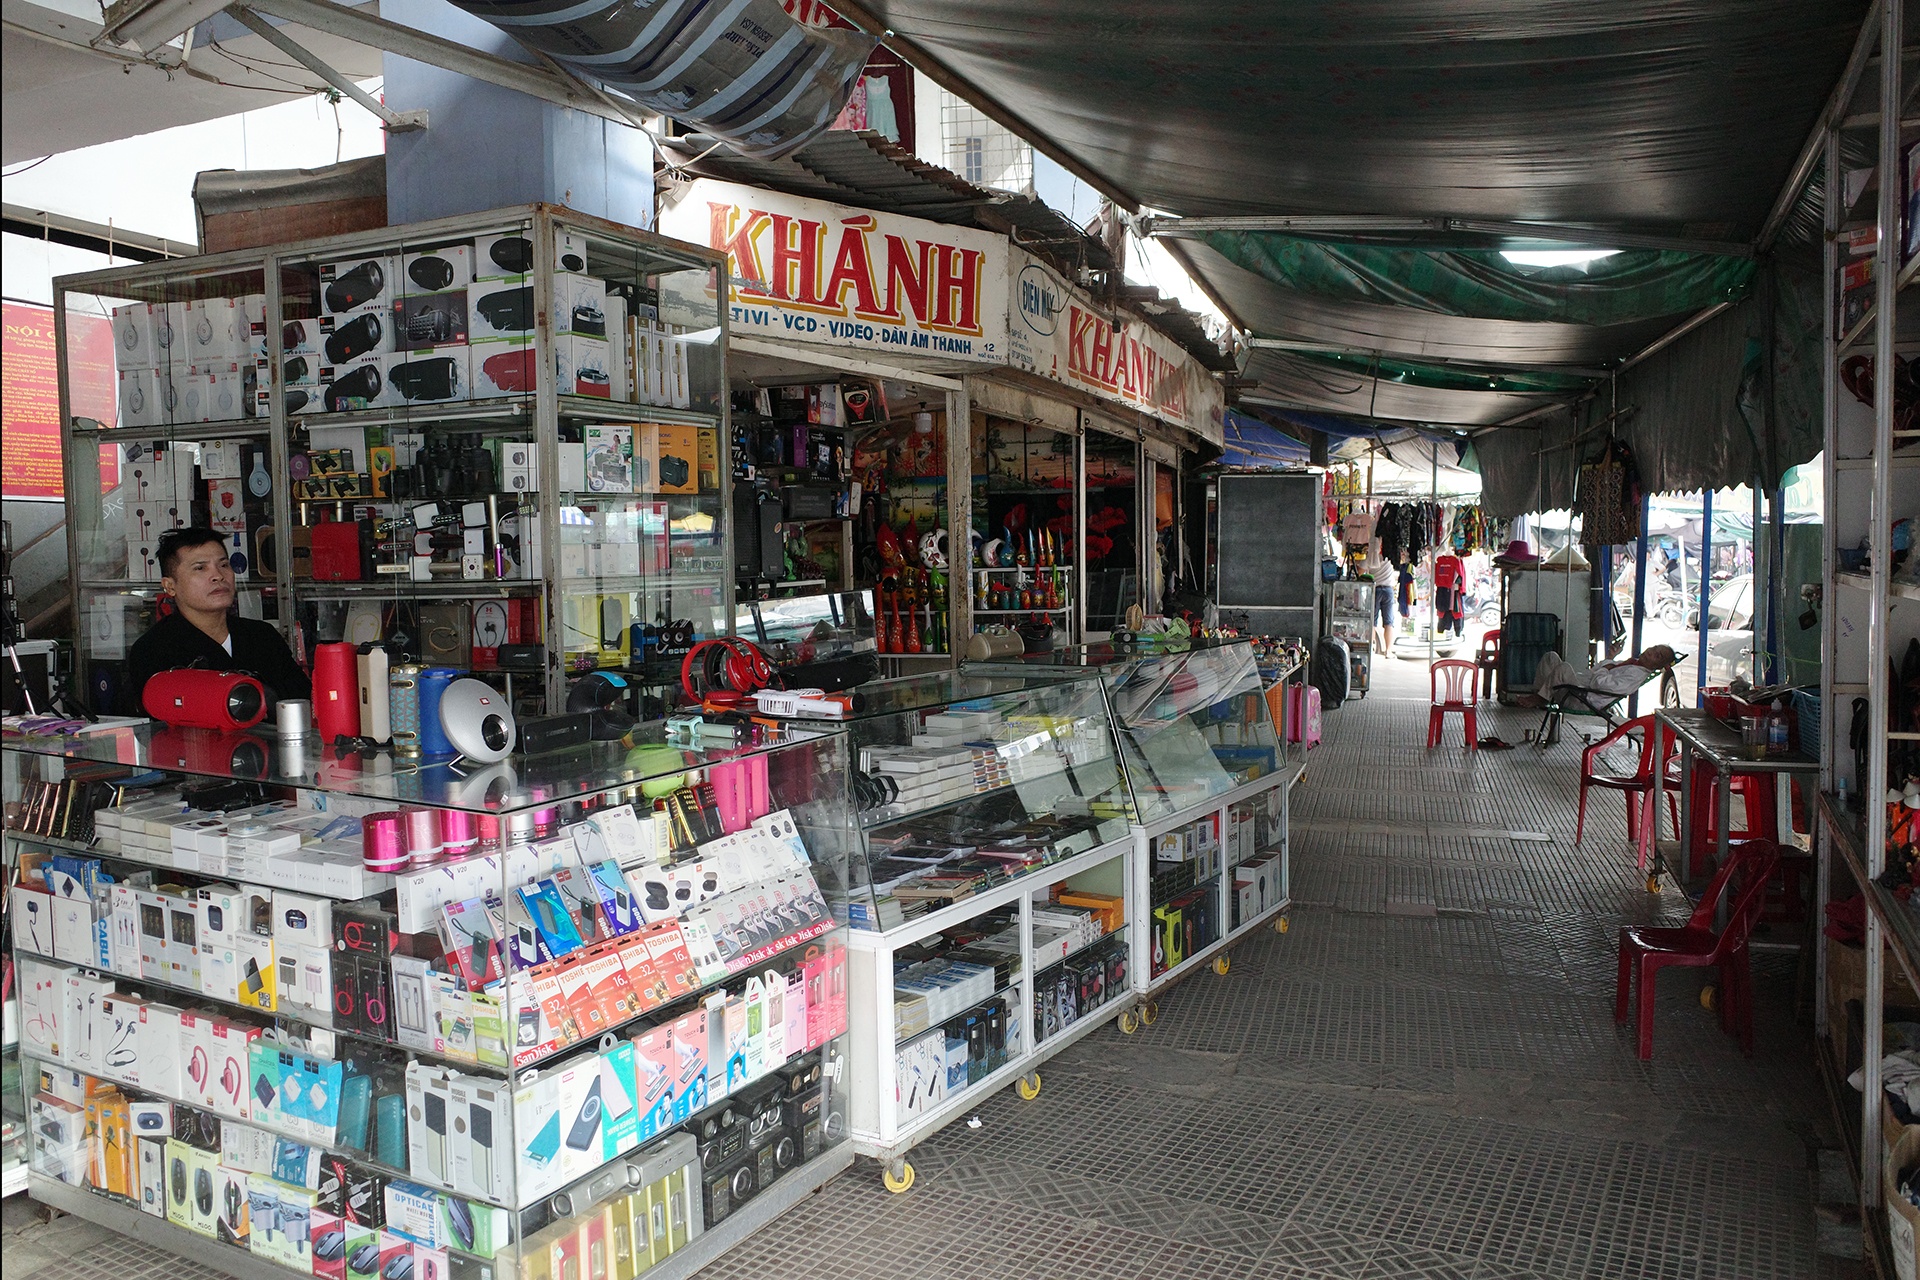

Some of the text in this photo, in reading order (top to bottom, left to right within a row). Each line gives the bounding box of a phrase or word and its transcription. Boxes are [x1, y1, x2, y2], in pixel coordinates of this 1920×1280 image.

[706, 201, 984, 336] KHÁNH
[732, 306, 972, 354] TIVI VCD VIDEO DÀN ÂM THANH
[984, 343, 994, 352] 12
[1068, 305, 1156, 401] KHÁNH
[456, 864, 468, 874] V20
[413, 877, 425, 886] V20
[98, 918, 110, 968] CABLE
[646, 934, 680, 948] TOSHIBA
[586, 958, 618, 974] TOSHIBA
[515, 1042, 554, 1068] SanDisk
[406, 1077, 421, 1086] MOBILE
[407, 1084, 421, 1093] POWER
[452, 1088, 466, 1098] MOBILE
[452, 1096, 466, 1104] POWER
